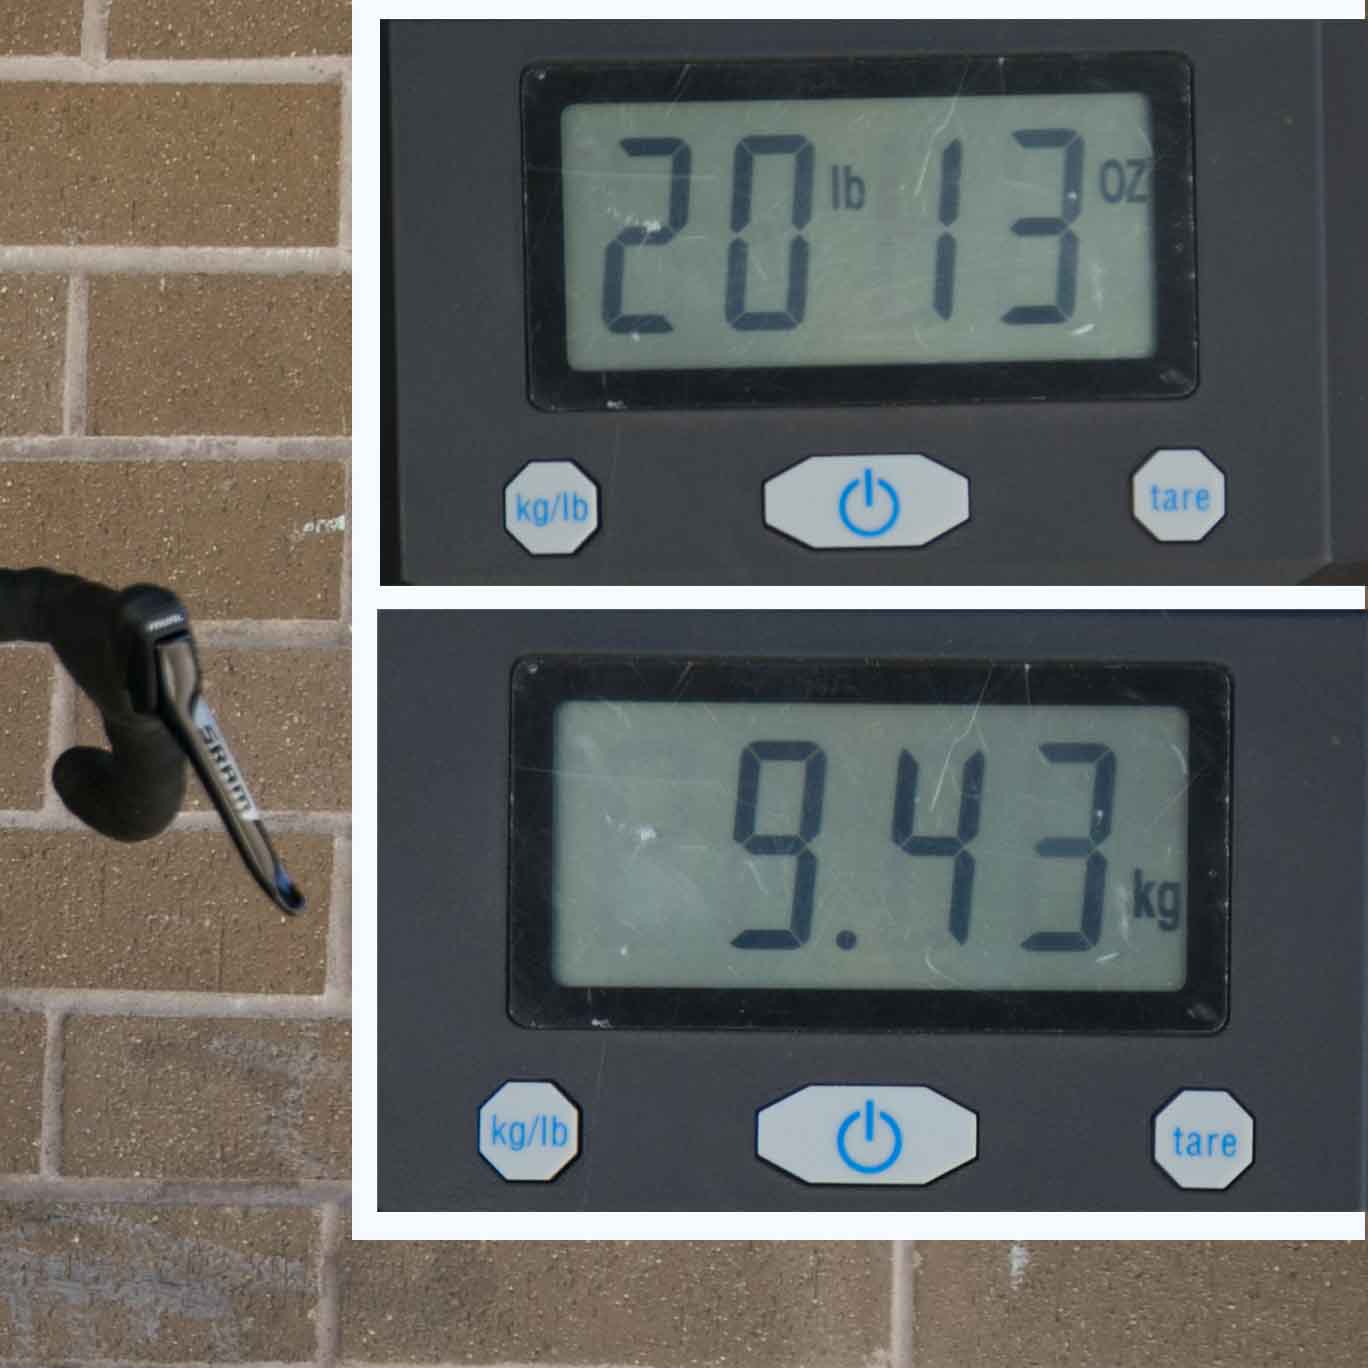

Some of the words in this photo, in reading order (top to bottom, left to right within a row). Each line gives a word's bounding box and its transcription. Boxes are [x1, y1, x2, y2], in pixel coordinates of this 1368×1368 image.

[602, 133, 816, 335] 20
[830, 165, 866, 212] lb
[932, 128, 1084, 325] 13
[515, 490, 590, 529] kg/lb
[1150, 481, 1211, 511] tare
[729, 740, 1118, 951] 9.43
[1131, 869, 1183, 931] kg
[490, 1114, 570, 1151] kg/lb
[1172, 1126, 1238, 1159] tare
